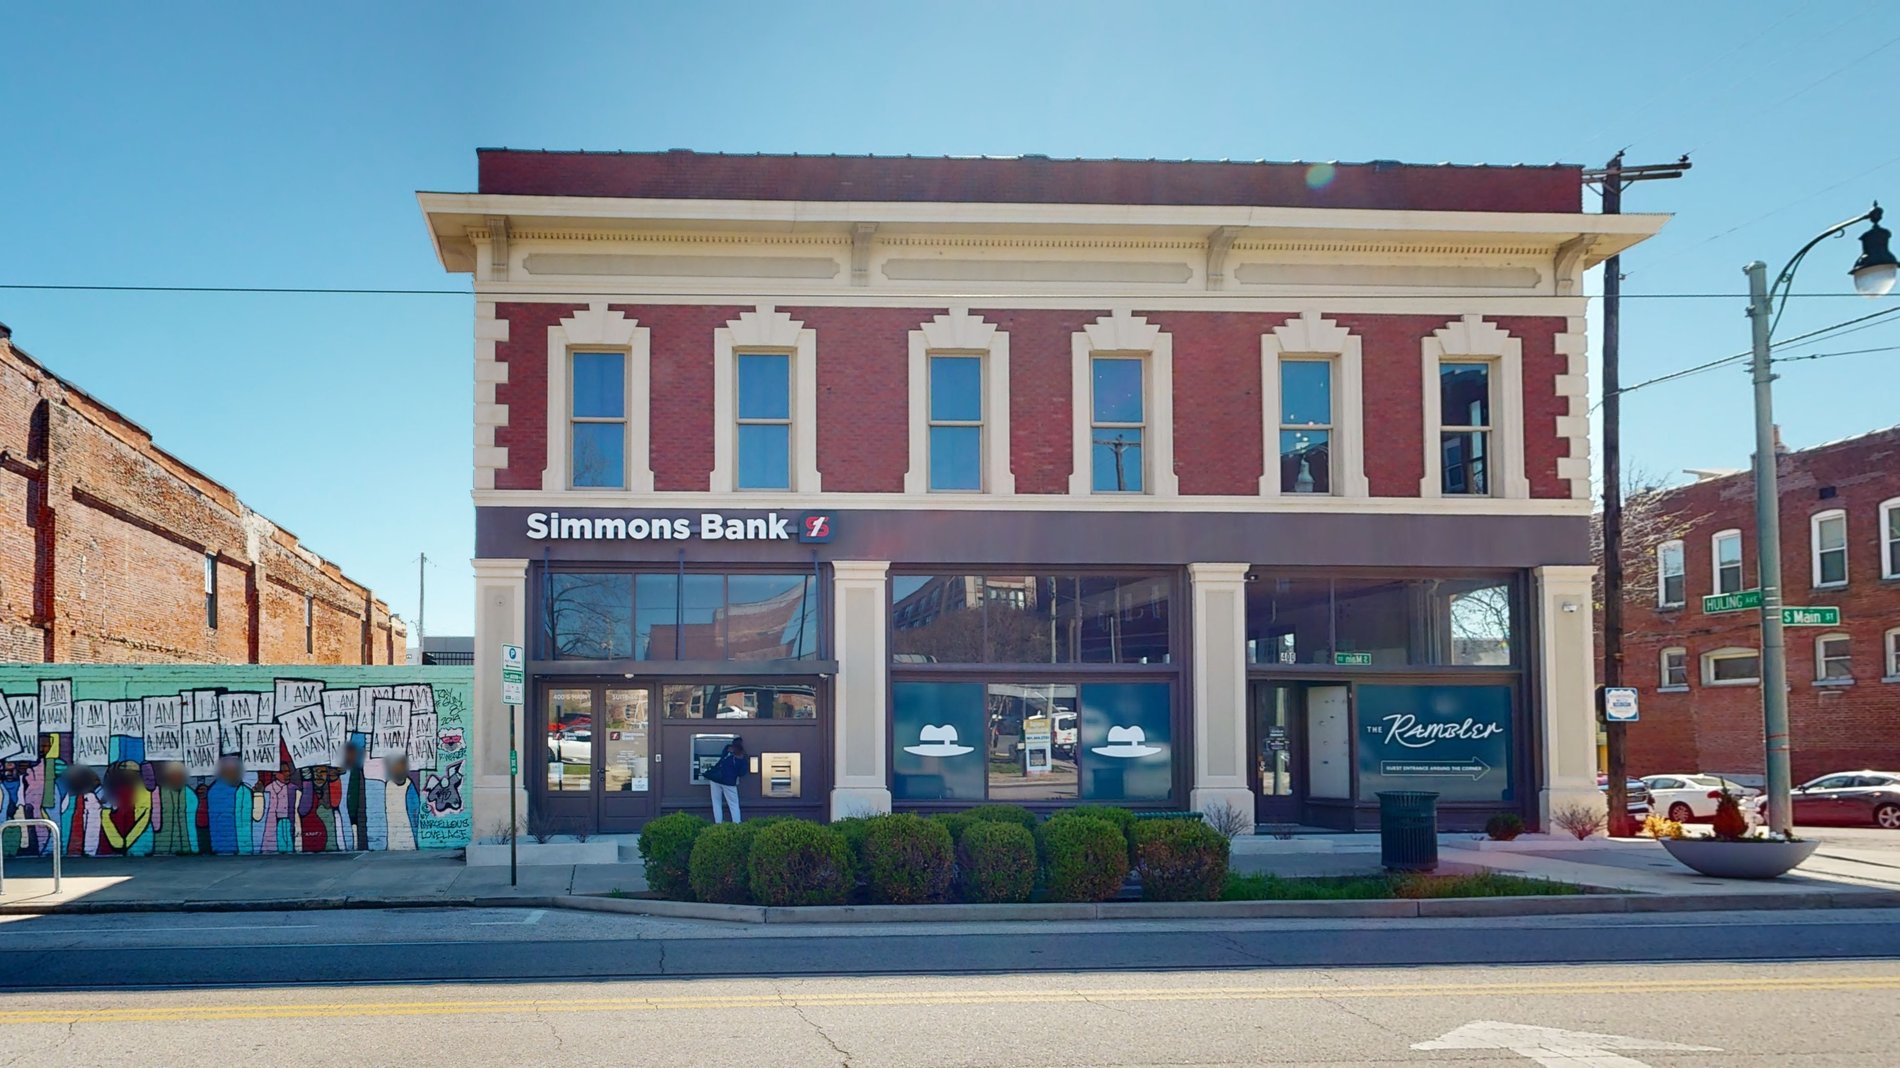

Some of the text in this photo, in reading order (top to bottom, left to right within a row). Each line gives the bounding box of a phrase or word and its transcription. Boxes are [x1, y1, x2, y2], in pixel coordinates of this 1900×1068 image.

[526, 512, 790, 540] Simmons Bank
[1706, 595, 1743, 612] HULING
[1783, 610, 1834, 623] S Main ST
[51, 683, 66, 702] AM
[294, 685, 316, 703] AM
[14, 699, 34, 719] AM
[87, 704, 105, 724] AM
[125, 702, 139, 715] AM
[155, 701, 175, 724] AM
[231, 698, 251, 718] AM
[260, 697, 270, 713] M
[386, 704, 402, 725] AM
[40, 706, 67, 724] A MAN
[120, 716, 141, 732] MAN
[298, 710, 319, 735] AM
[195, 726, 213, 744] AM
[416, 717, 433, 735] AM
[23, 735, 36, 756] AN
[147, 729, 179, 751] A MAN
[257, 728, 274, 744] AM
[374, 730, 405, 749] A MAN
[79, 735, 107, 758] A MAN
[244, 747, 275, 763] A MAN
[292, 744, 302, 760] A
[300, 734, 326, 756] MAN
[186, 747, 215, 768] A MAN
